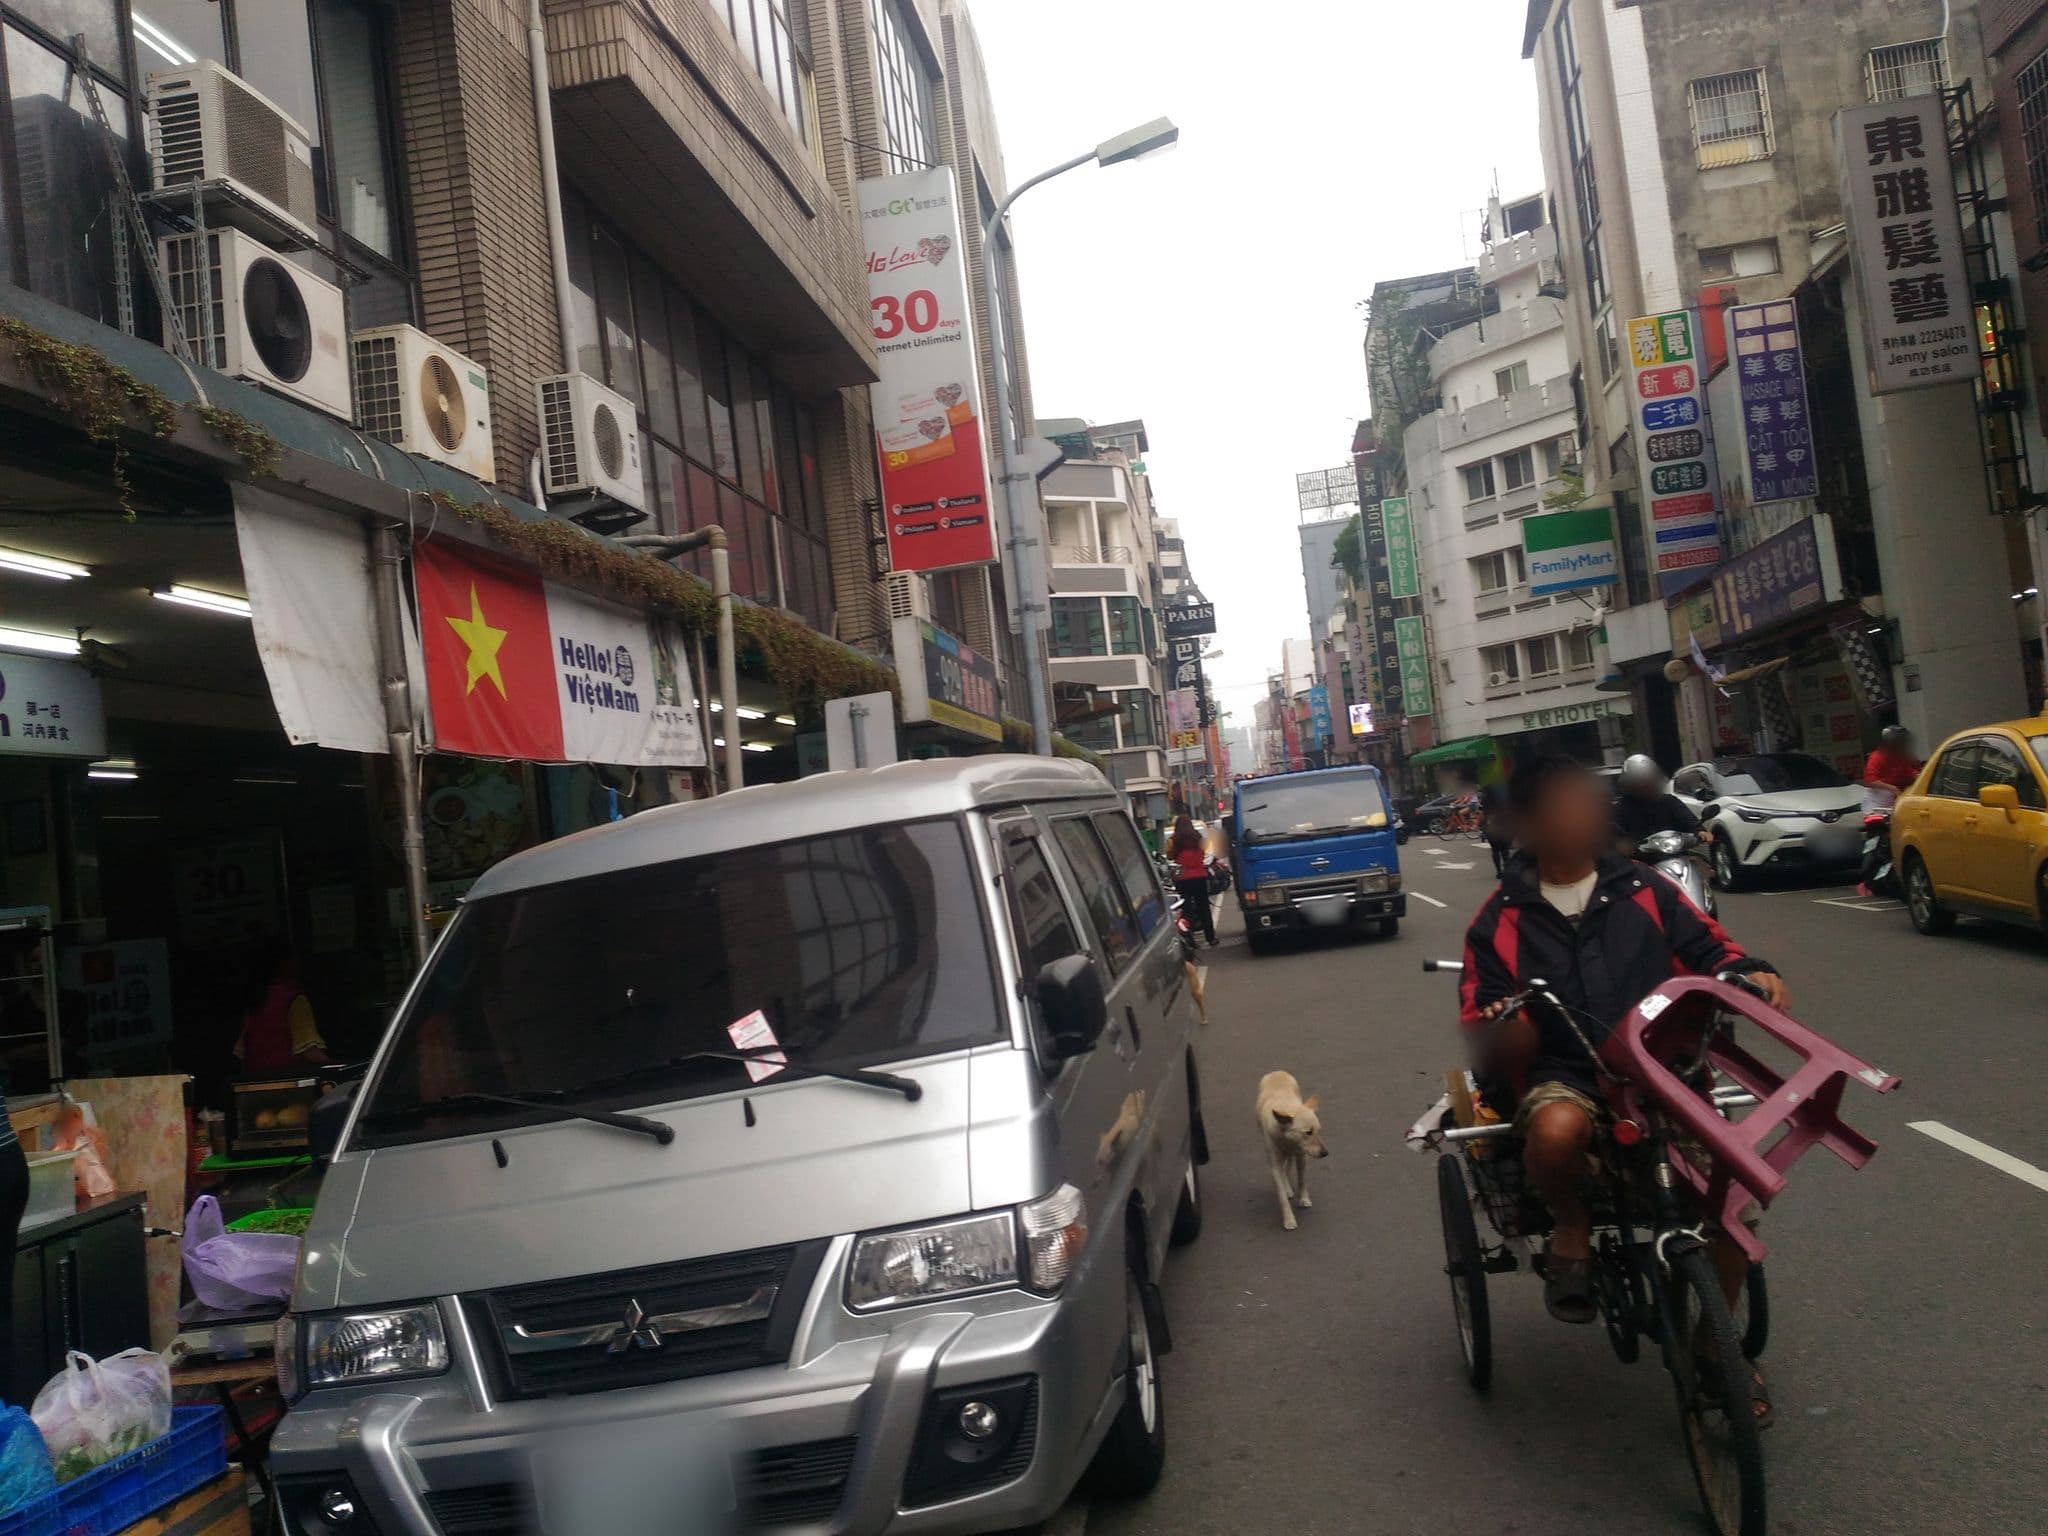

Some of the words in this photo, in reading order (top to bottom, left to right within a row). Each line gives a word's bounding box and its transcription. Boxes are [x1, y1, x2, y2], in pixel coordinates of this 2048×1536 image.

[1863, 115, 1949, 323] 東雅髮藝
[871, 289, 938, 339] 30
[940, 318, 960, 328] days
[914, 331, 961, 348] Unlimited
[1744, 352, 1797, 377] 美容
[1888, 351, 1928, 366] Jenny
[1932, 345, 1968, 359] salon
[1647, 401, 1695, 426] 二手機
[1756, 447, 1805, 473] 美甲
[1366, 503, 1383, 544] HOTEL
[1532, 552, 1613, 575] FamilyMart
[1168, 606, 1213, 622] PARIS
[560, 637, 612, 676] Hello!
[22, 723, 70, 741] 河內美食
